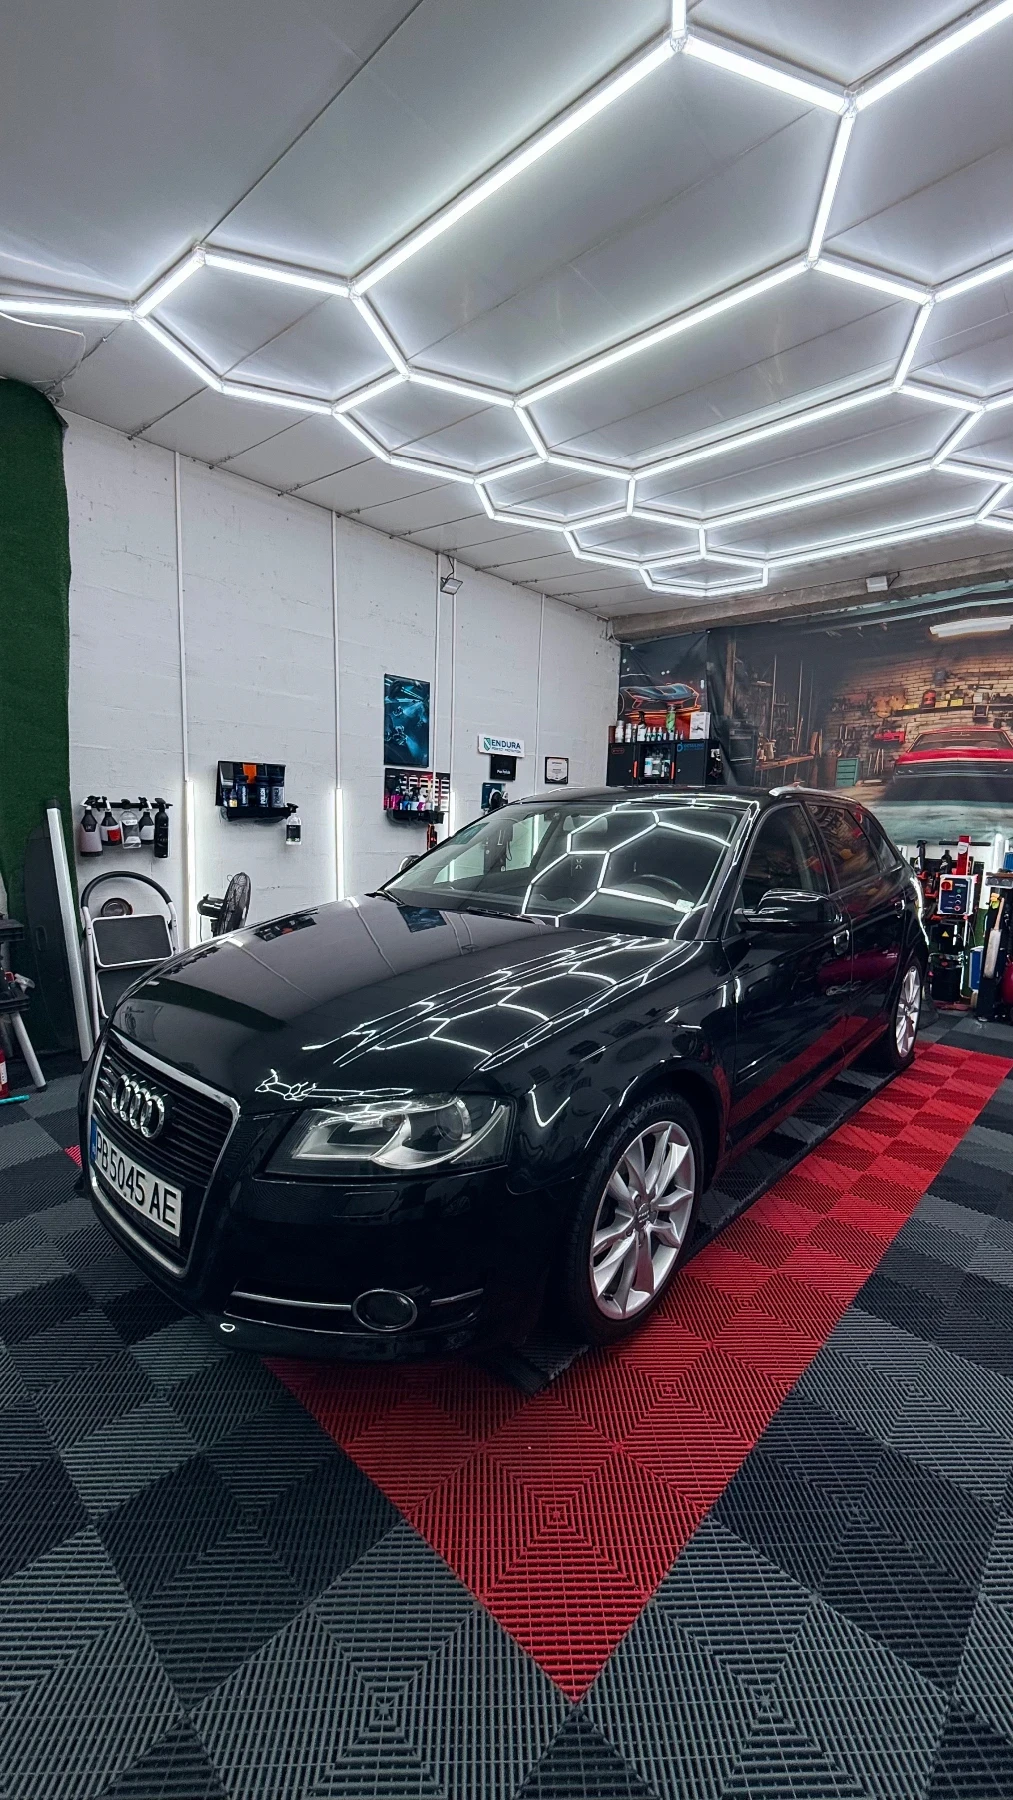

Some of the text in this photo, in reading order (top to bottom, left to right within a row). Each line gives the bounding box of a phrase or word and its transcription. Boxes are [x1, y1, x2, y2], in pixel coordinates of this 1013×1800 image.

[492, 740, 520, 749] ENDURA
[97, 1131, 176, 1228] PB 5045 AE
